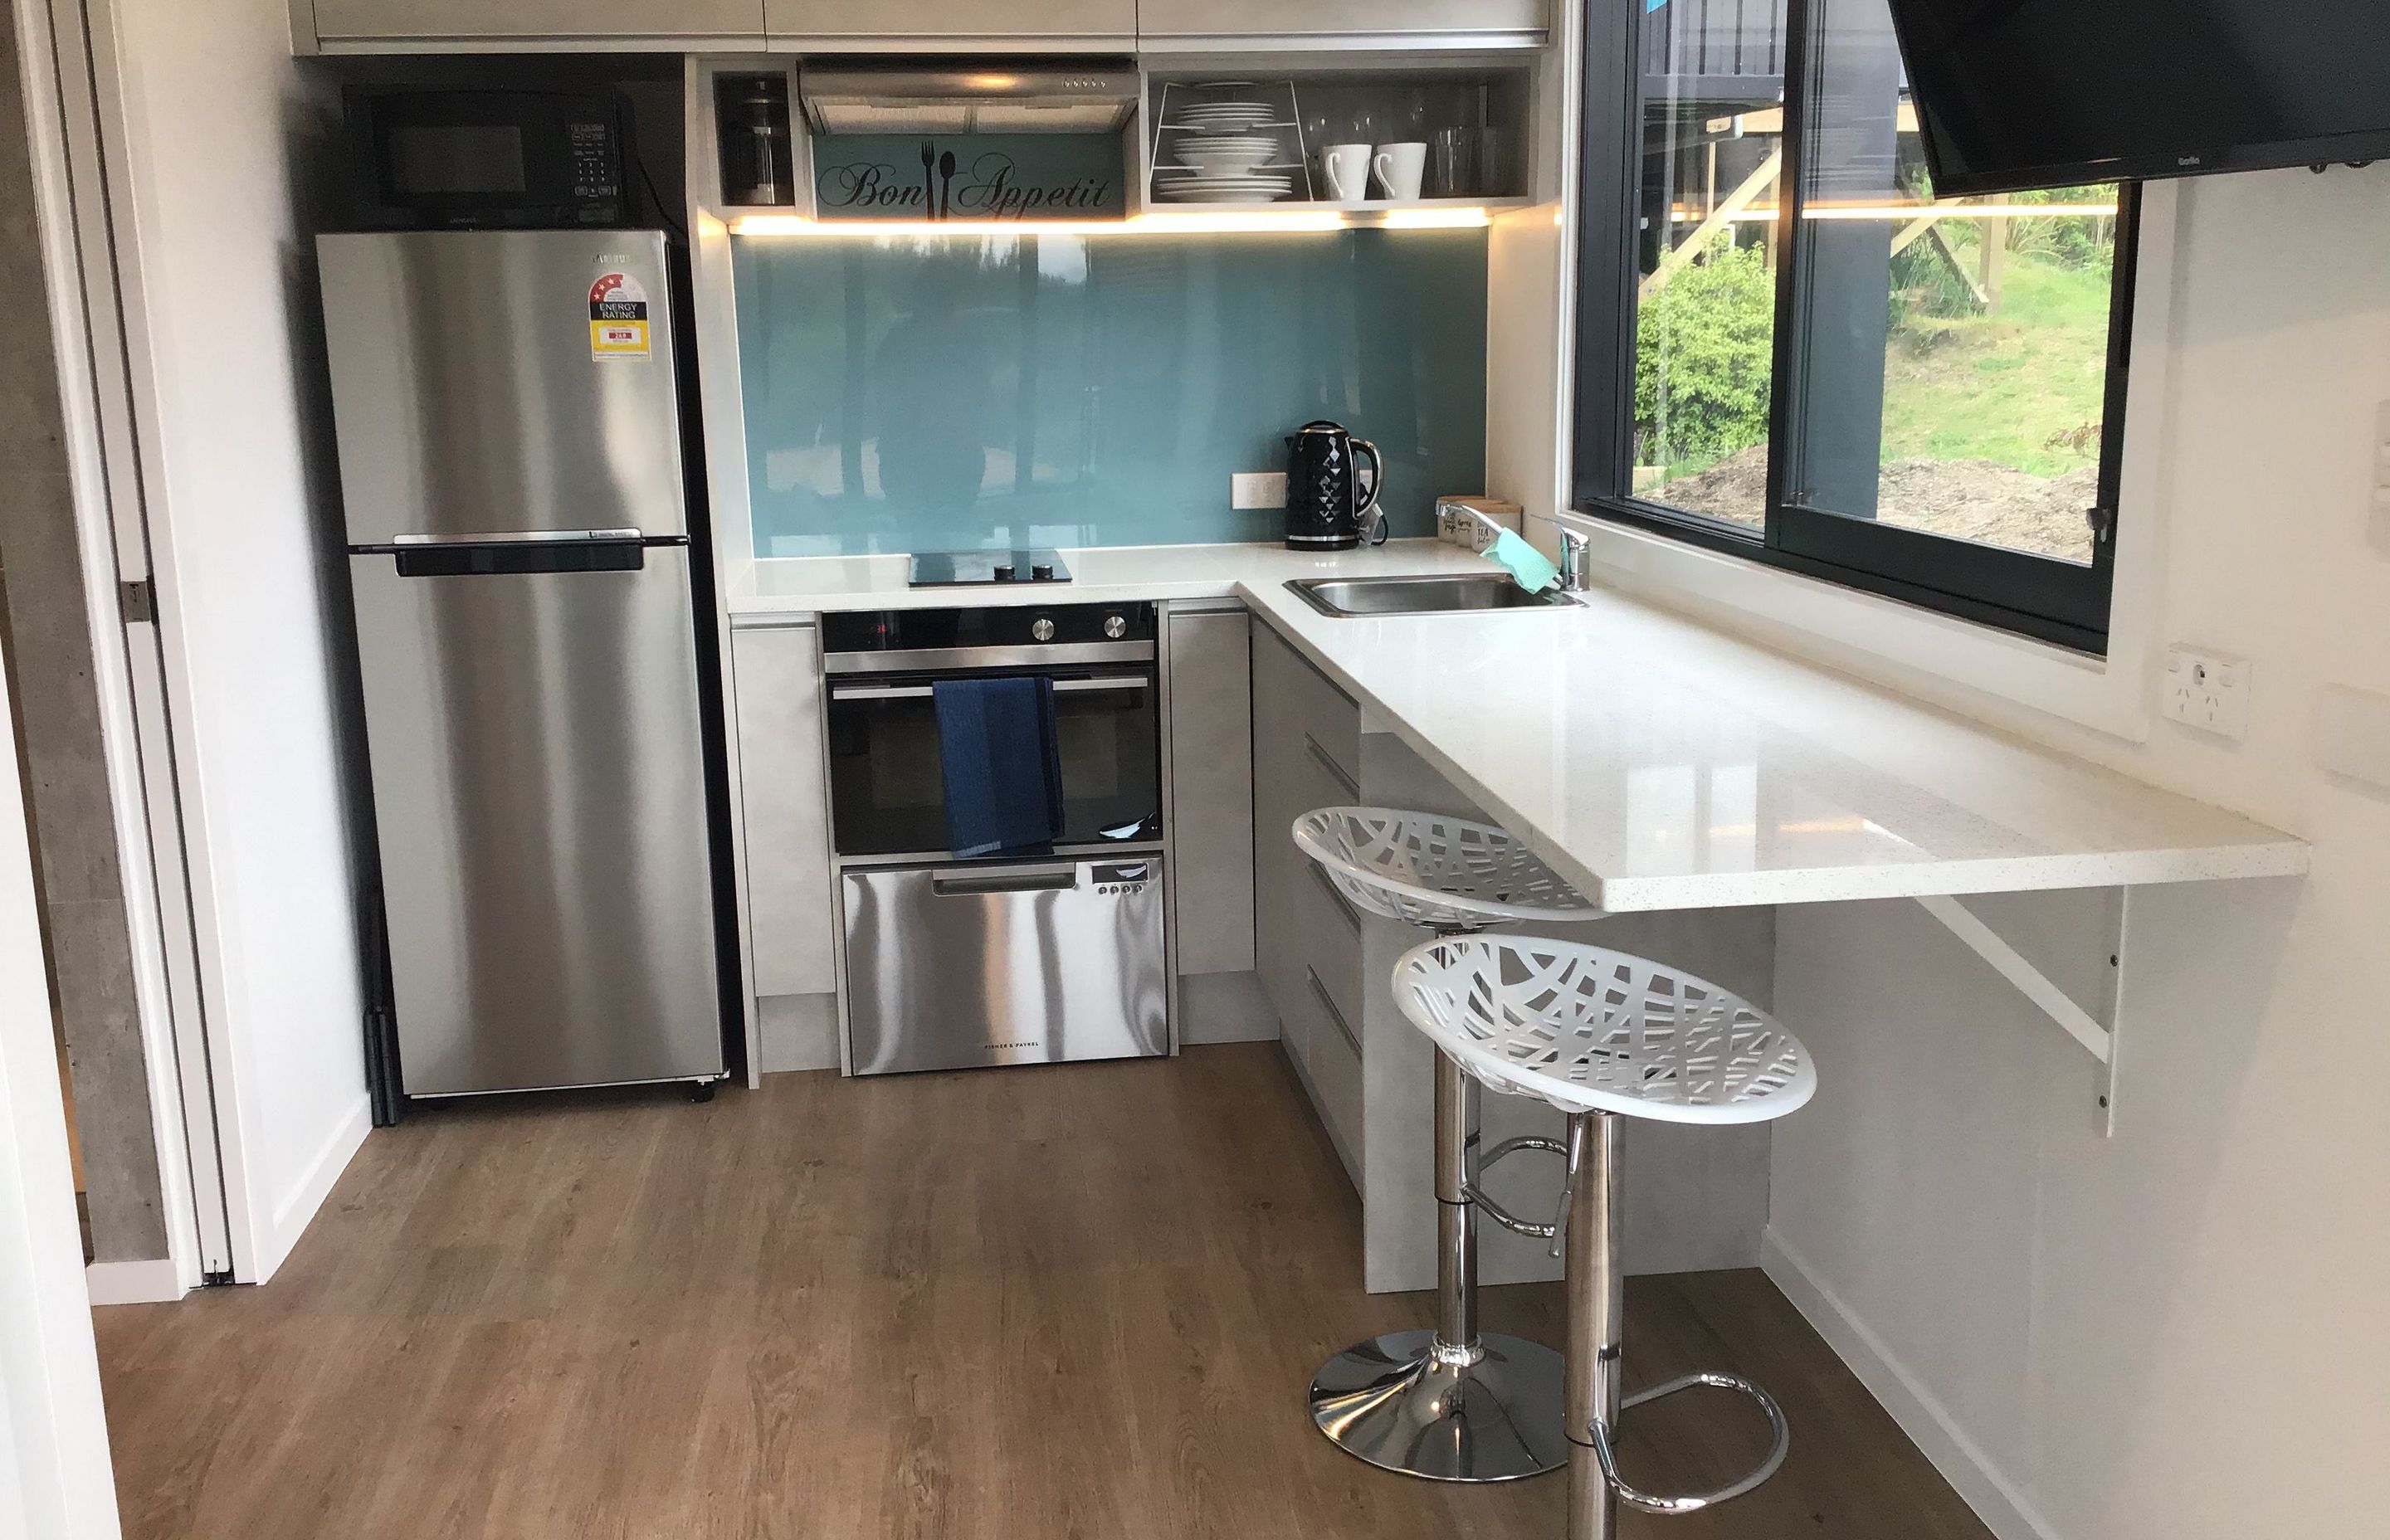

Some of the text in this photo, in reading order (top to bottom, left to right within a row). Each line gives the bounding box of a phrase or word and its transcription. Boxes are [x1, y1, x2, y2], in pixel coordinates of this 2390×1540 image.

[817, 153, 1110, 221] Bon Appetit
[590, 253, 638, 265] AMSU
[599, 303, 638, 311] ENERGY
[602, 310, 636, 319] RATING
